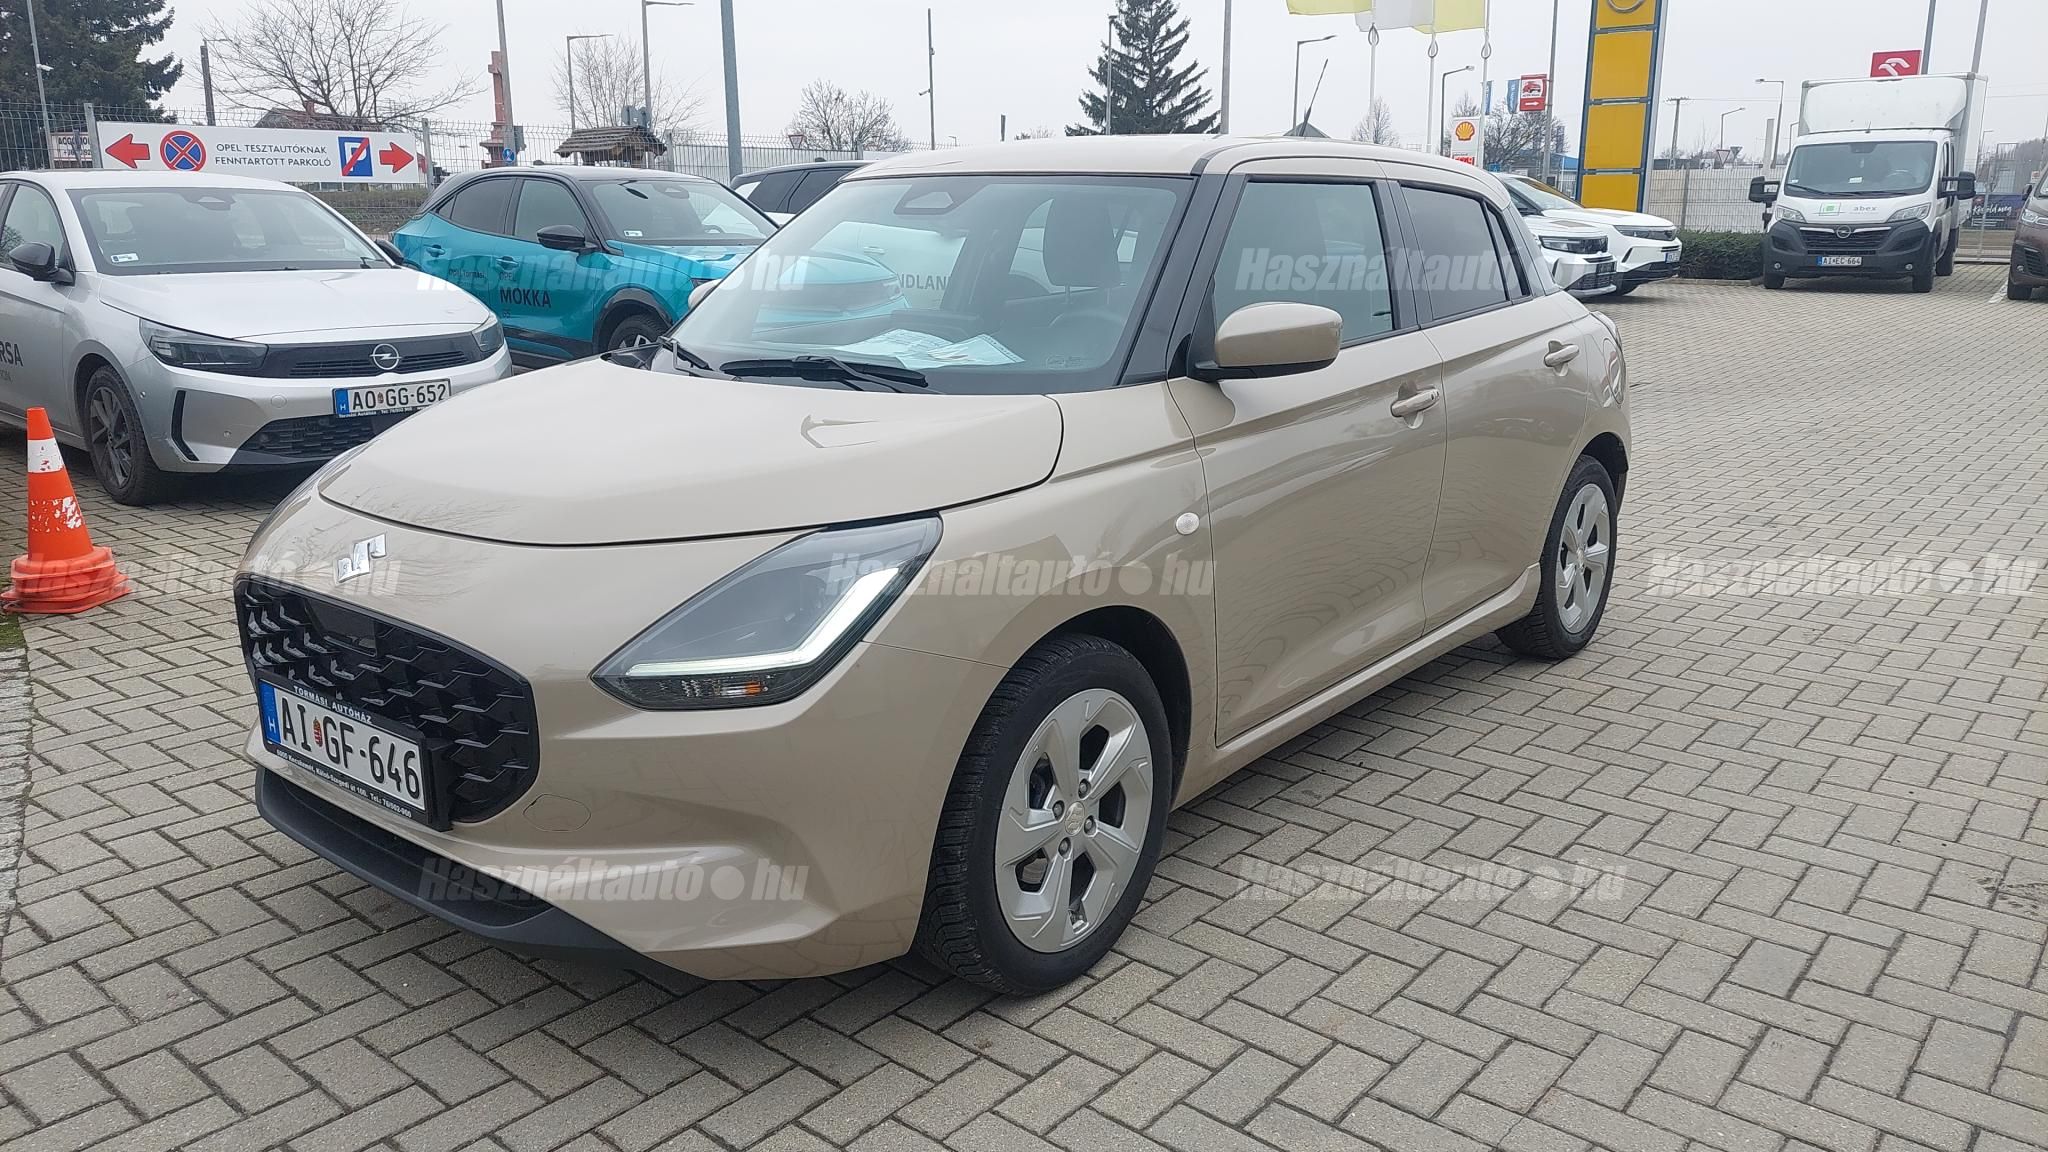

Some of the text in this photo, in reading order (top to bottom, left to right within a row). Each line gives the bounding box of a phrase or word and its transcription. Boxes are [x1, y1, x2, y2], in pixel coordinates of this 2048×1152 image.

[216, 143, 327, 154] OPEL TESZTAUTÓKNAK
[215, 156, 331, 167] FENNTARTOTT PARKOLÓ
[500, 287, 552, 308] MOKKA
[352, 383, 447, 411] AO GG-652
[332, 701, 372, 724] AUTÓHÁZ
[267, 715, 277, 734] H
[281, 697, 420, 800] AI GF-646
